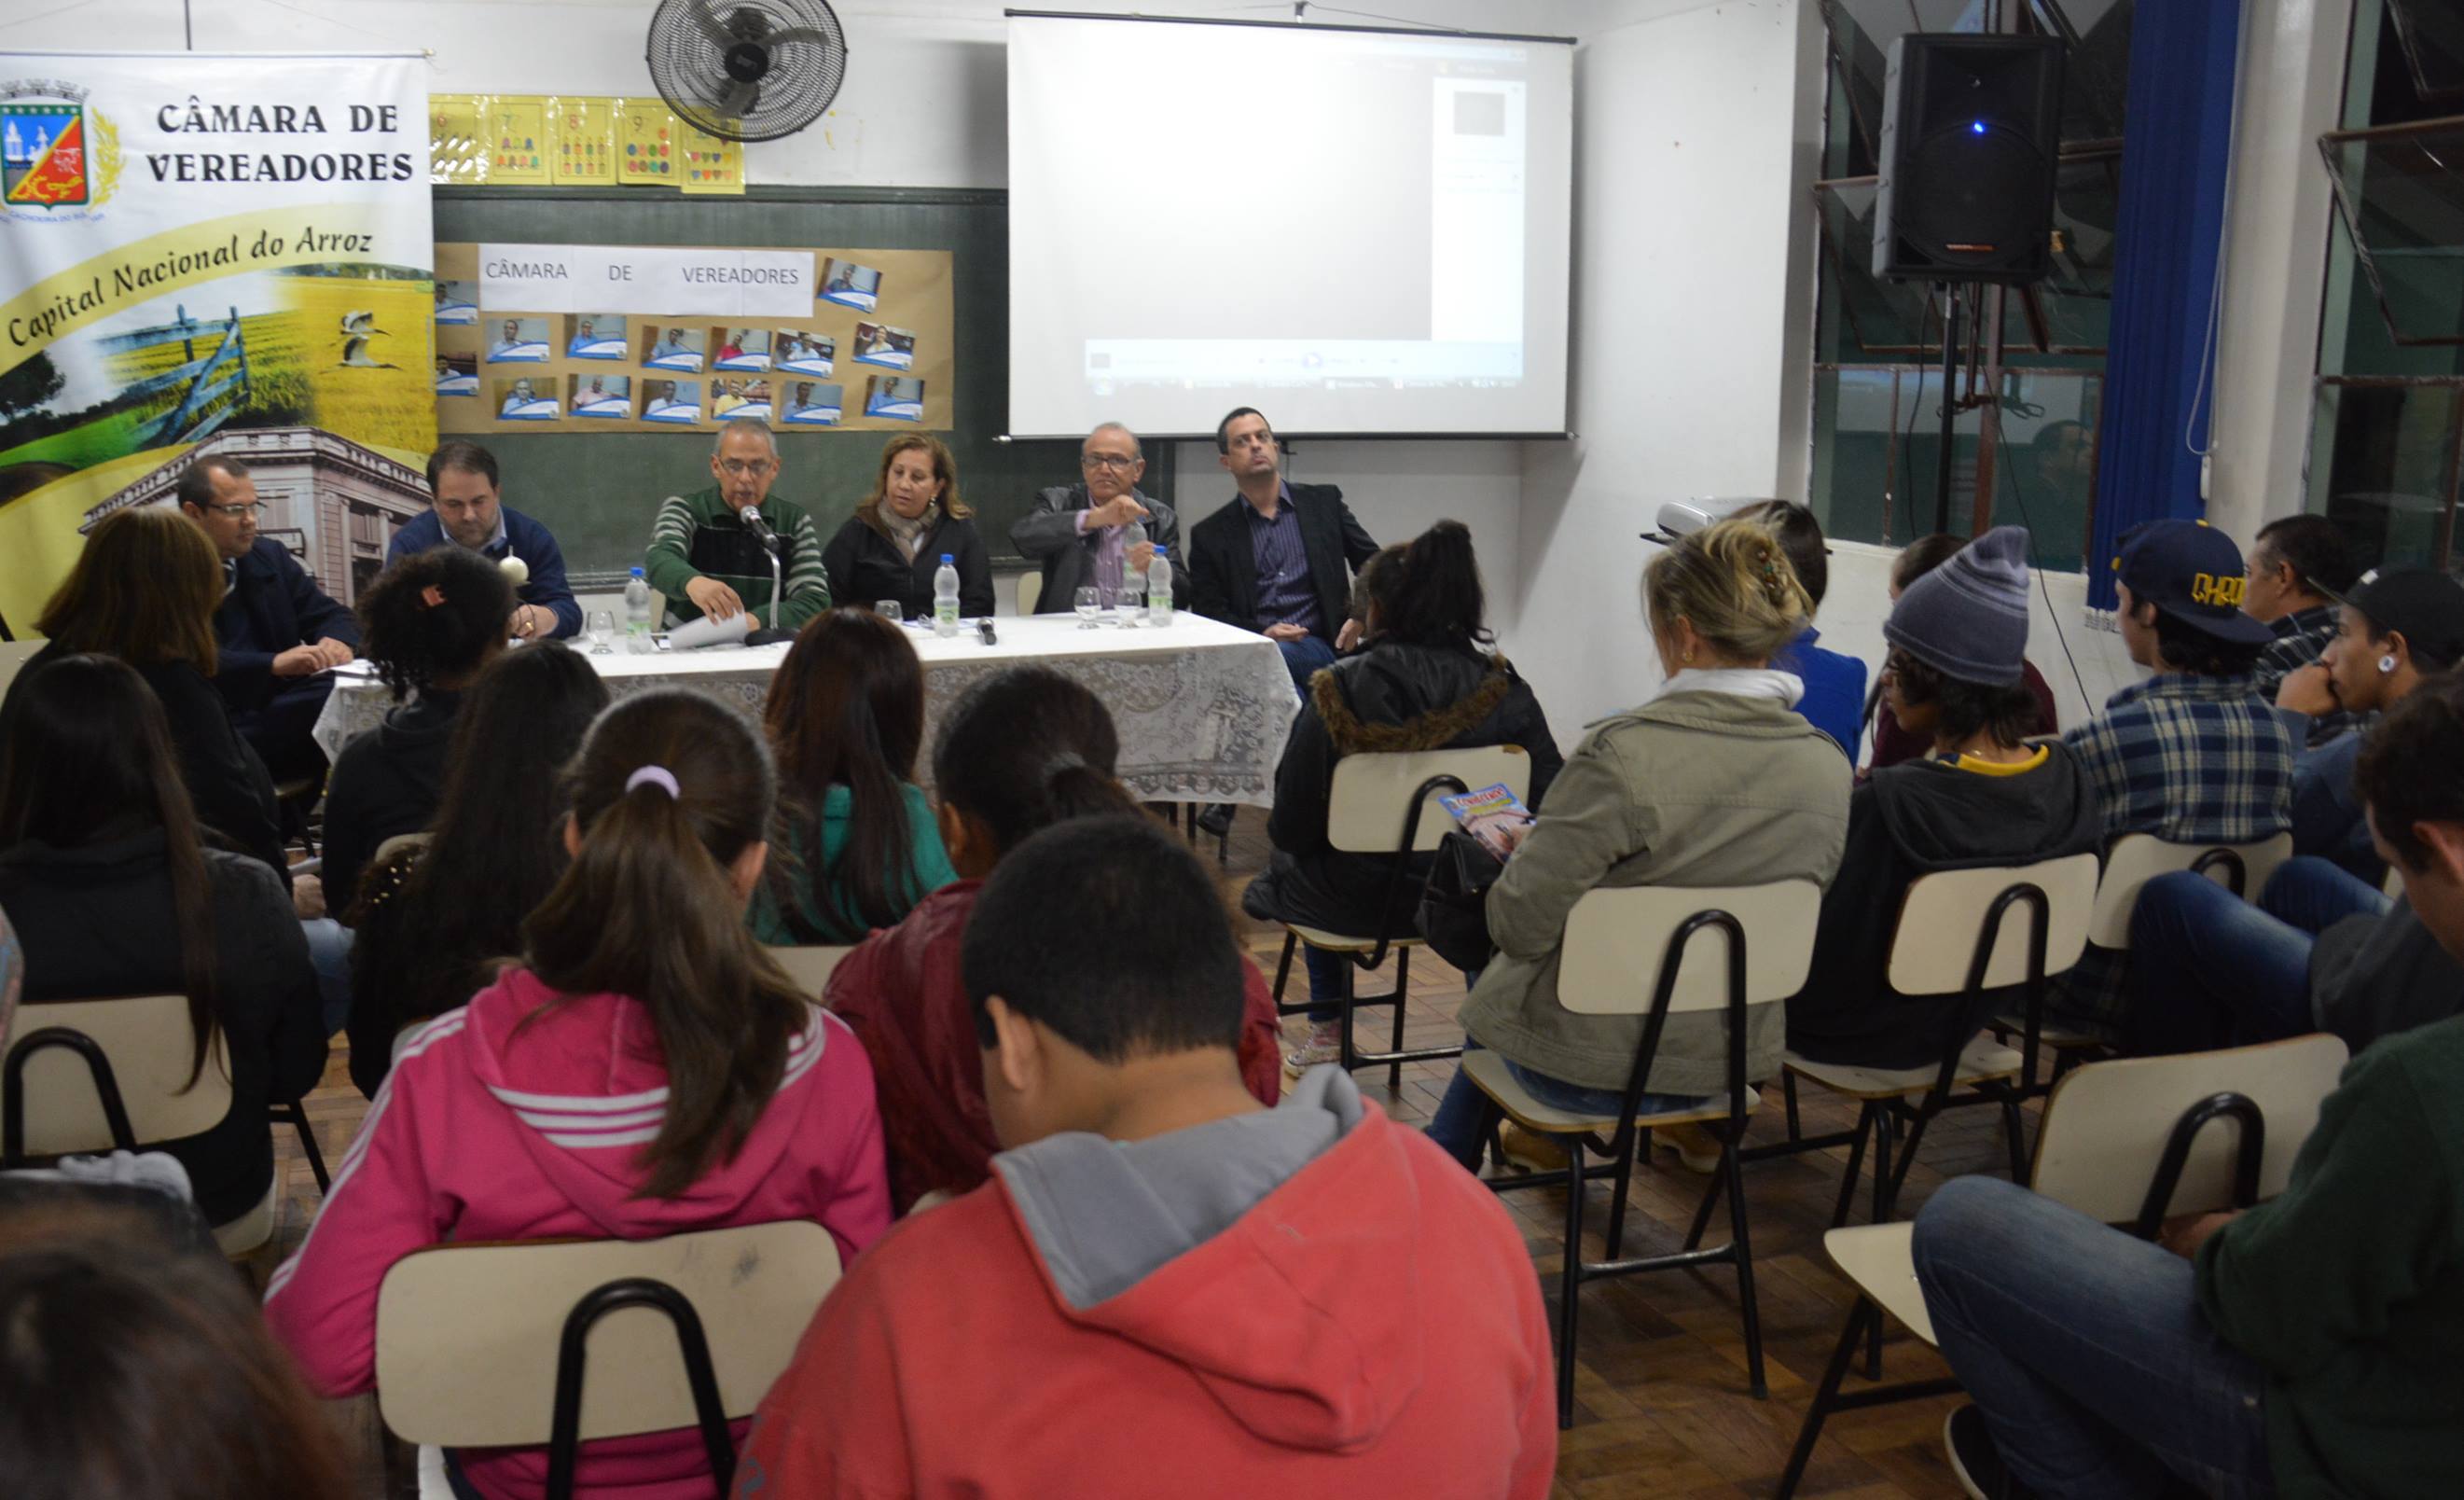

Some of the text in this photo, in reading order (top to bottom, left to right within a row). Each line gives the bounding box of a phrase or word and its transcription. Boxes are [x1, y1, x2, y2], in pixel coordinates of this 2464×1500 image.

[157, 94, 397, 133] CÂMARA DE
[145, 153, 413, 182] VEREADORES
[7, 225, 373, 348] Capital Nacional do Arroz
[485, 259, 799, 285] CÂMARA DE VEREADORES
